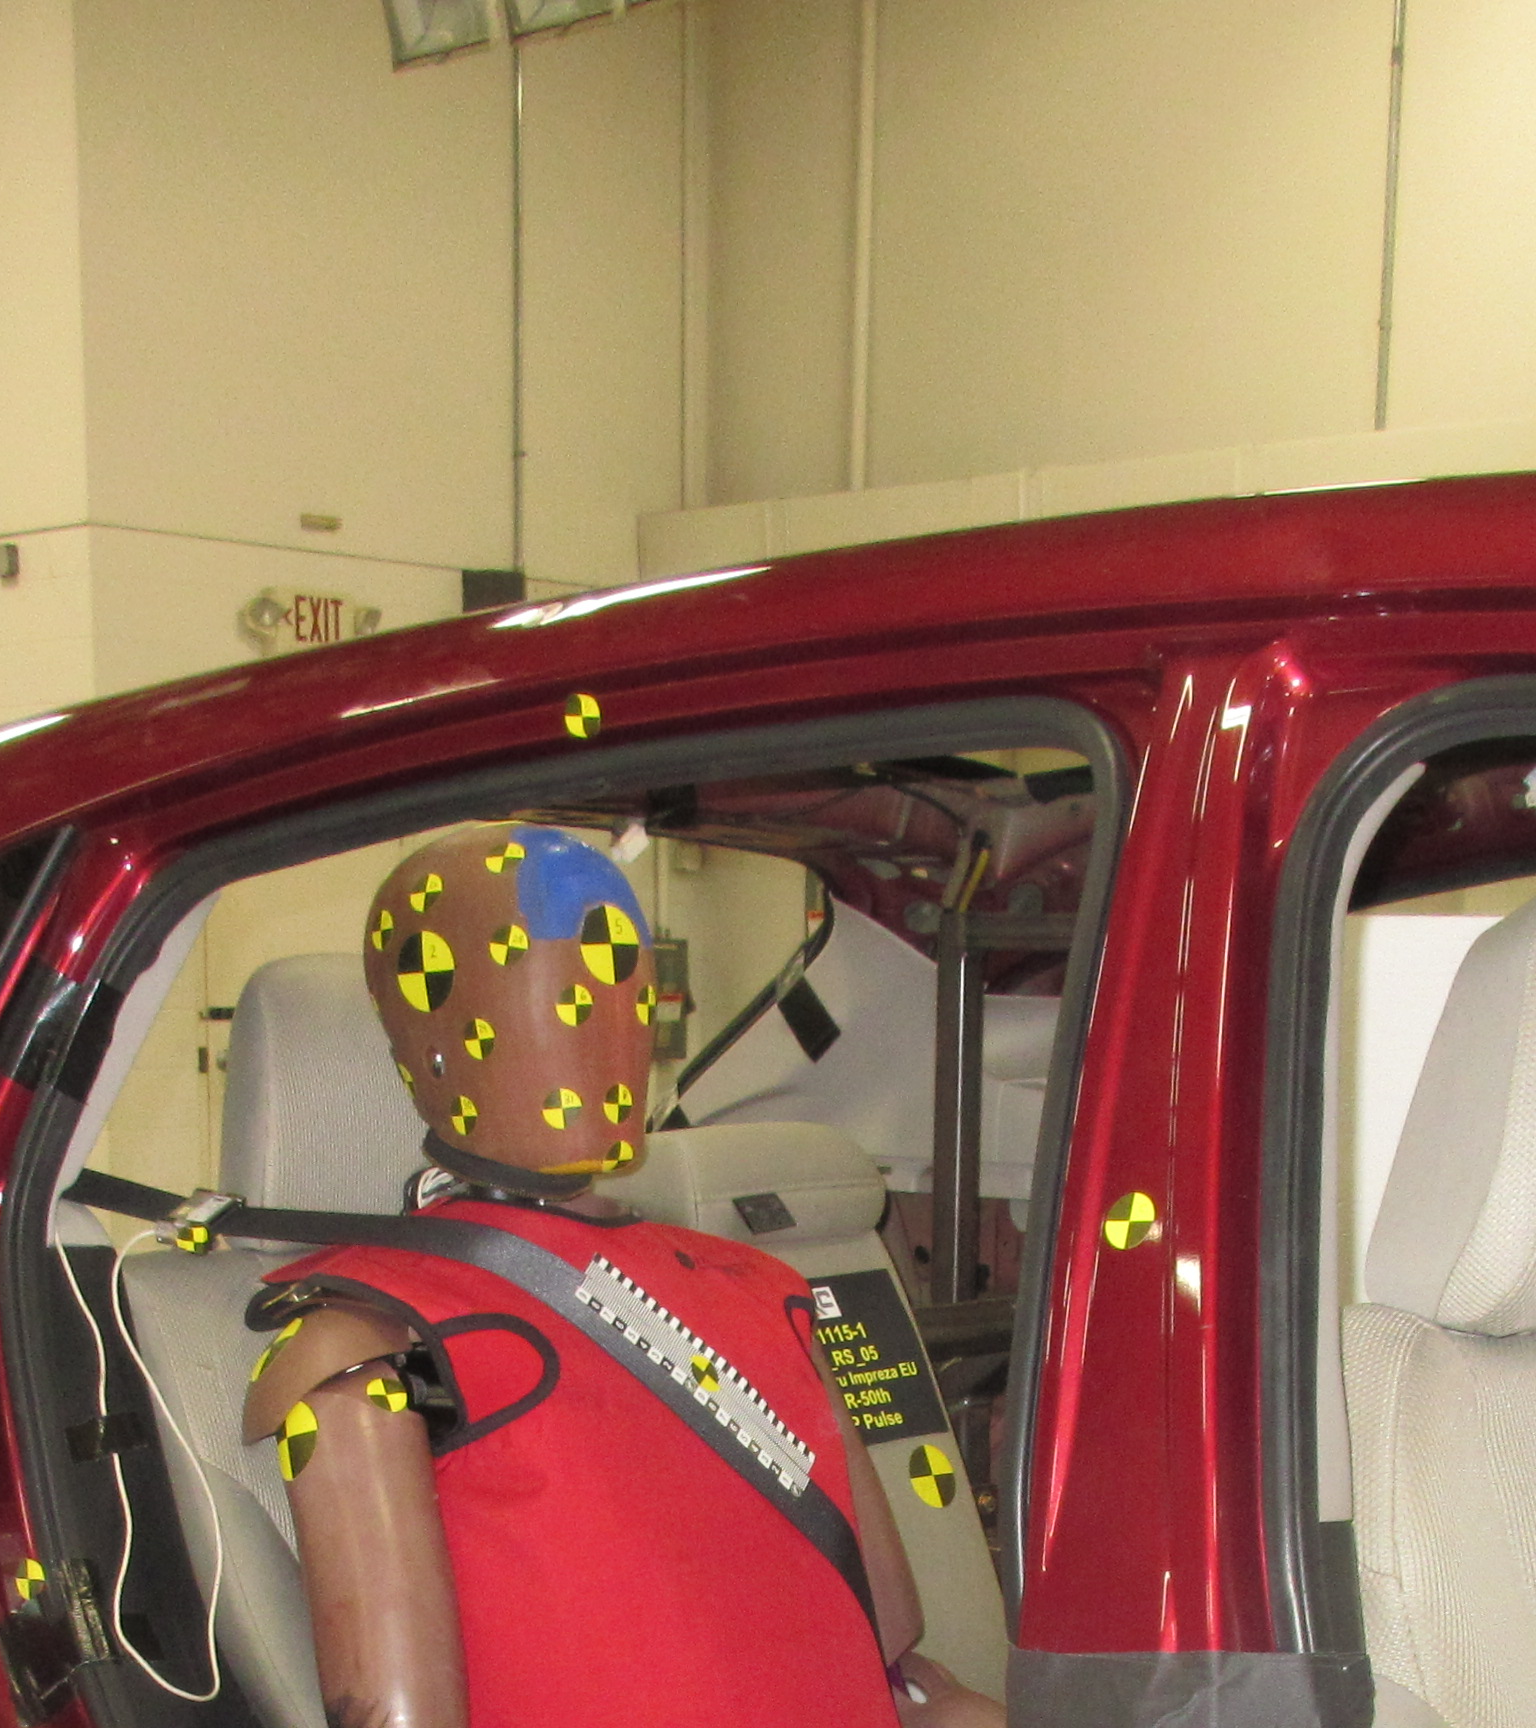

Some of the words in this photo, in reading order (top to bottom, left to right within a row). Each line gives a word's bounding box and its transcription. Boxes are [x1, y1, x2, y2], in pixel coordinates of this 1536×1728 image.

[295, 595, 344, 642] EXIT
[849, 1367, 898, 1386] Impreza
[899, 1361, 917, 1376] EU
[863, 1411, 903, 1429] Pulse
